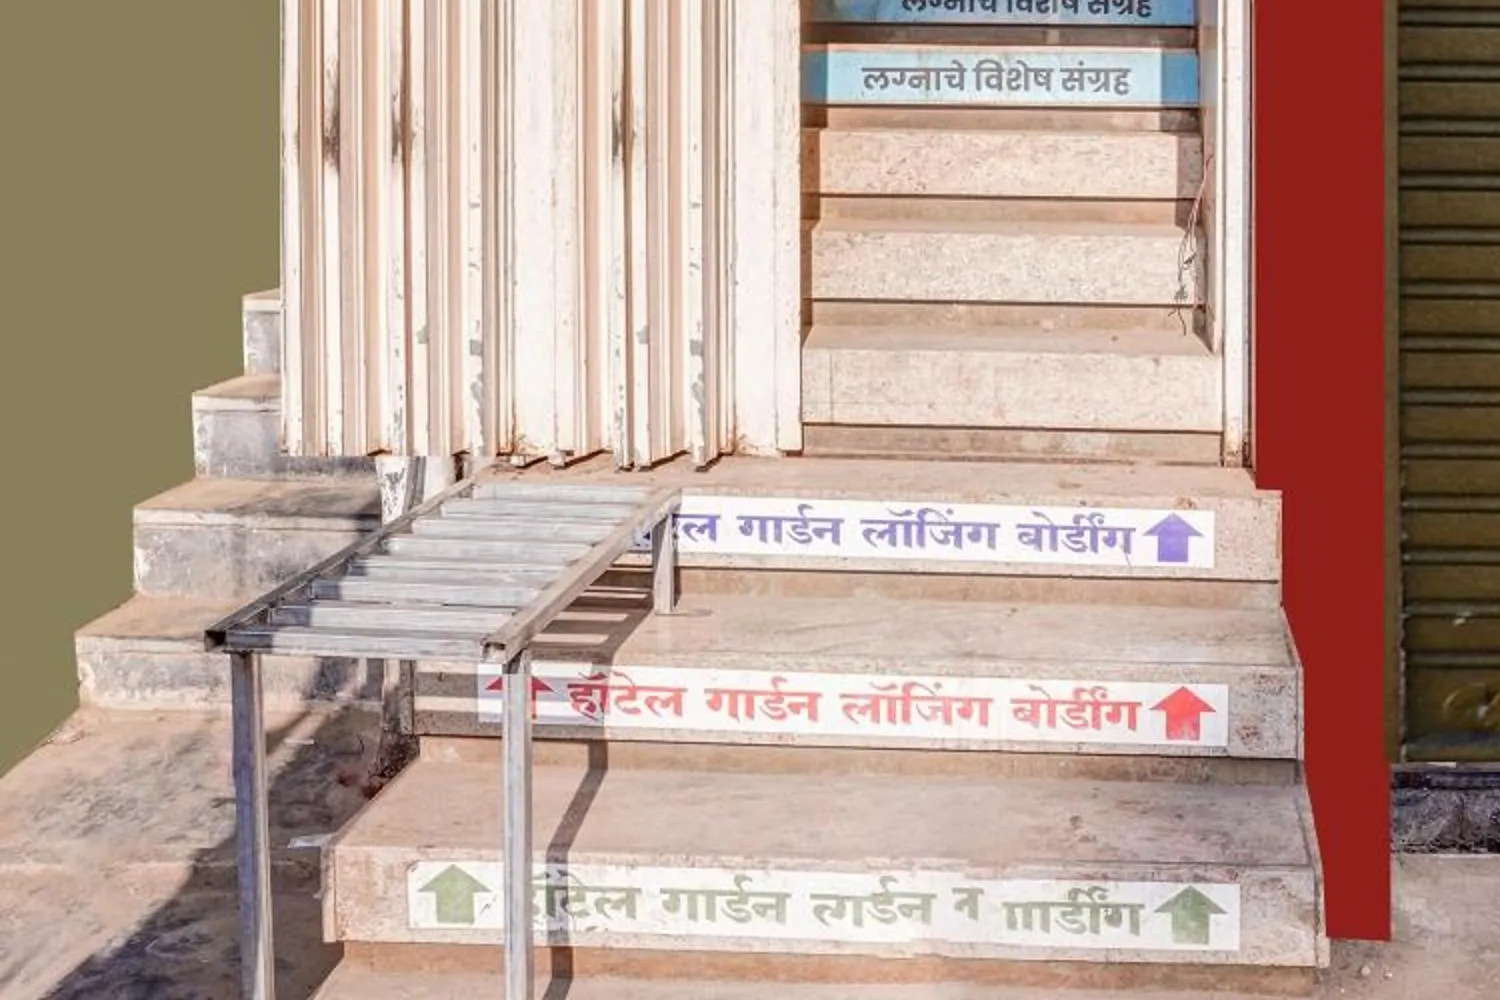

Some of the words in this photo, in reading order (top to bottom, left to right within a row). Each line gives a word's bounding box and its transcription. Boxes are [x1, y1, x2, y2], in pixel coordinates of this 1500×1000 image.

[862, 60, 967, 91] लग्नाचे
[973, 59, 1055, 92] विशेष
[1060, 61, 1133, 95] संग्रह
[736, 504, 844, 545] गार्डन
[860, 507, 1001, 549] लॉजिंग
[567, 671, 688, 721] हॉटेल
[704, 676, 823, 722] गार्डन
[839, 681, 994, 727] लॉजिंग
[660, 874, 792, 924] गार्डन
